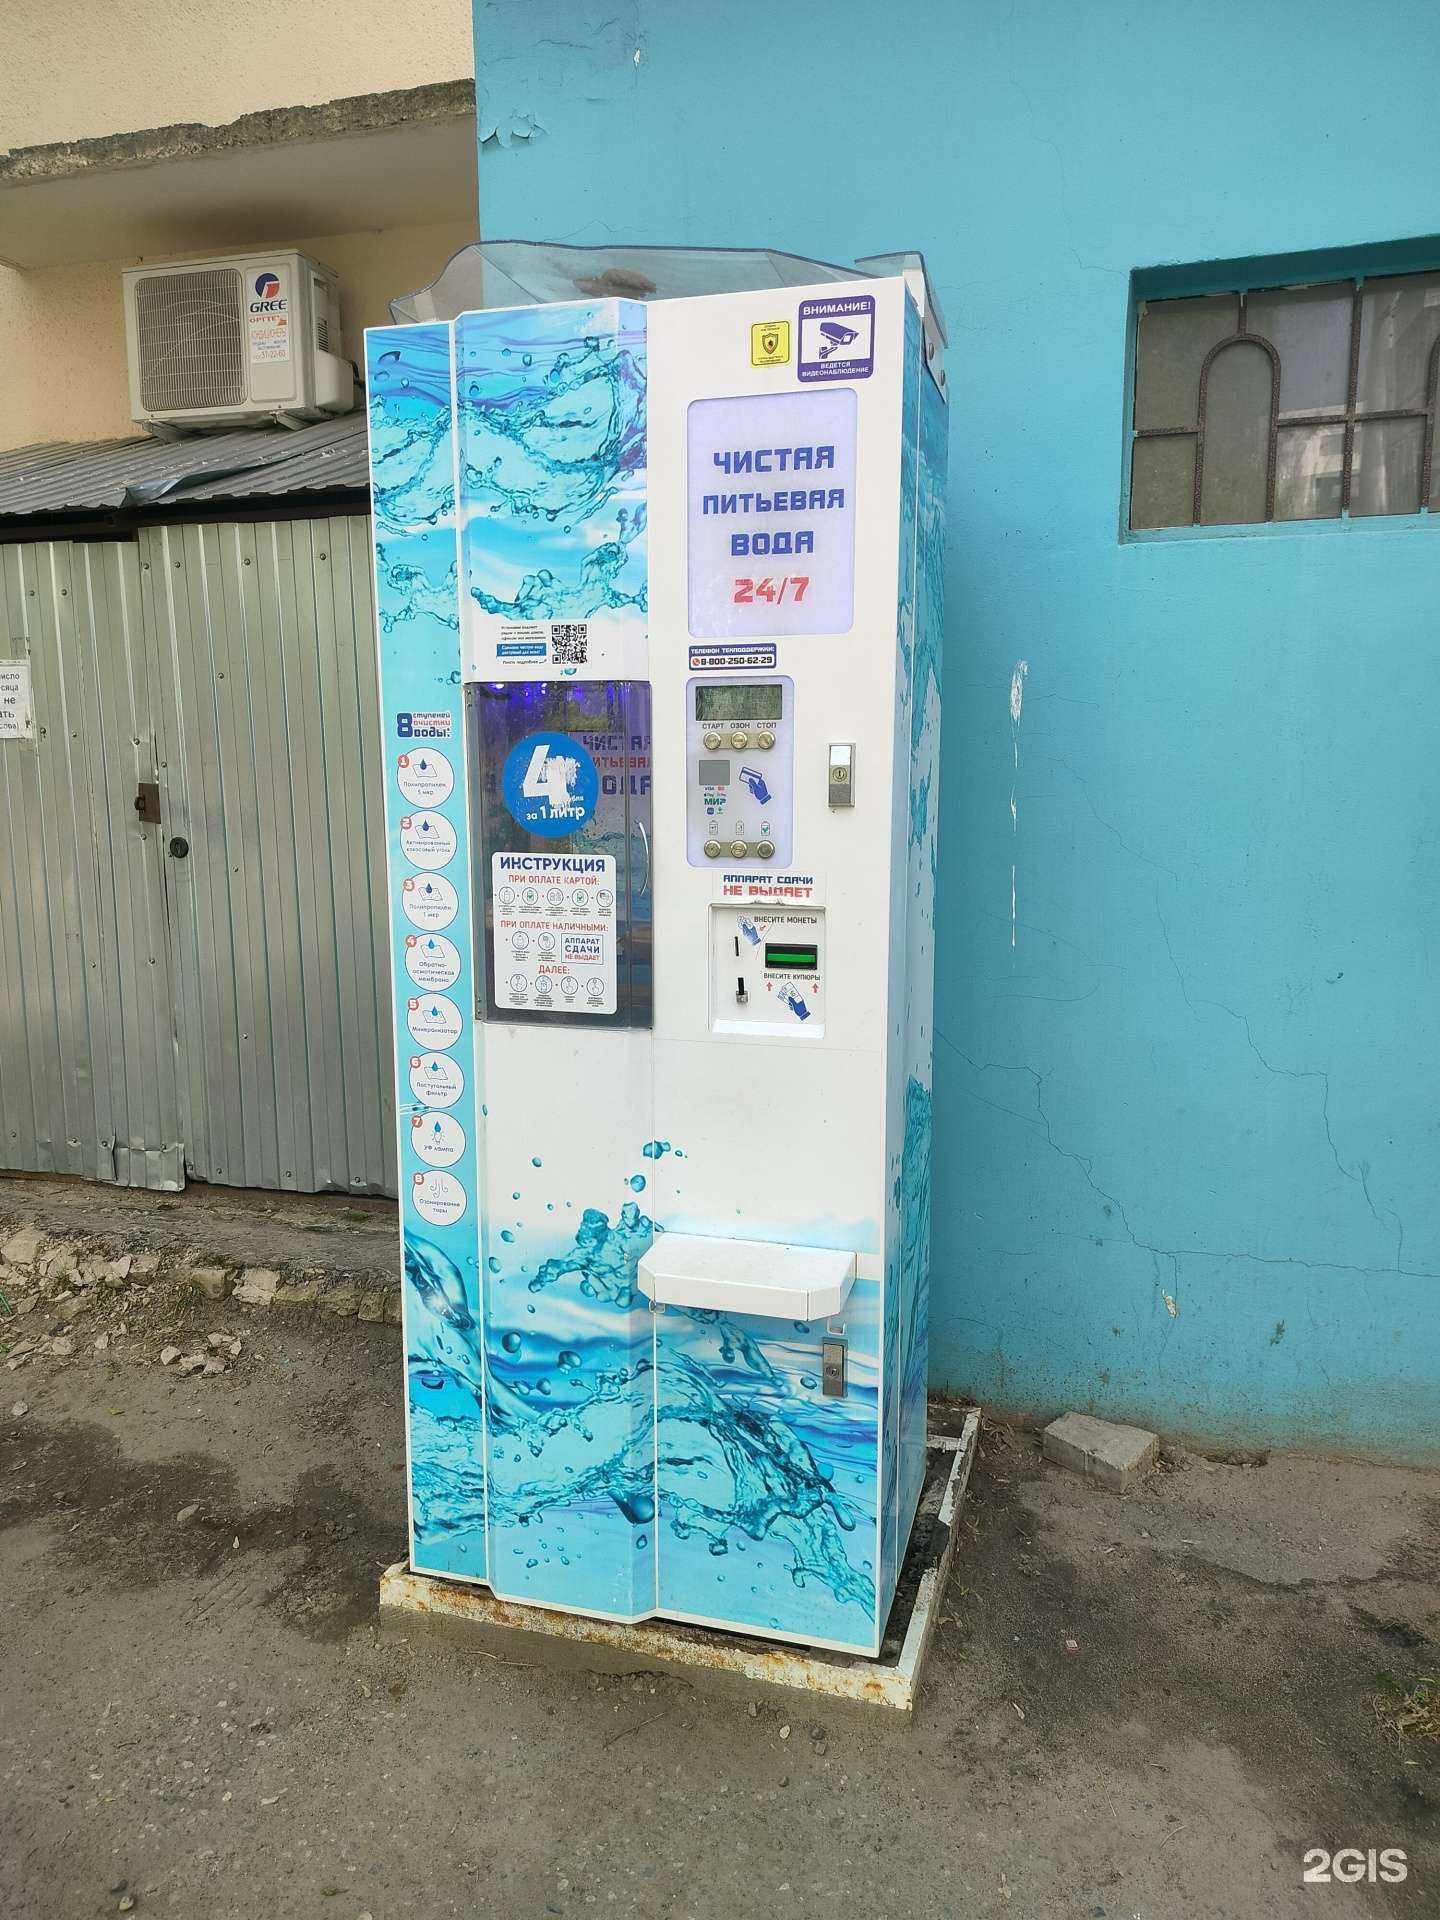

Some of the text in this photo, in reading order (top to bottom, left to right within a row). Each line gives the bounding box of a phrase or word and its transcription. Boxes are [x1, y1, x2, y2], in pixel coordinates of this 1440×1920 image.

[250, 299, 287, 312] GREE
[803, 301, 871, 315] ВНИМАНИЕ!
[820, 361, 851, 369] ВЕДЕТСЯ
[802, 367, 869, 377] ВИДЕОНАБЛЮДЕНИЕ
[713, 446, 834, 474] ЧИСТАЯ
[703, 489, 844, 514] ПИТЬЕВАЯ
[731, 531, 814, 556] ВОДА
[734, 577, 809, 604] 24/7
[397, 713, 413, 738] 8
[702, 721, 777, 730] СТАРТ ОЗОН СТОП
[414, 726, 451, 738] воды:
[540, 806, 547, 819] 1
[549, 807, 585, 820] литр
[501, 857, 605, 873] ИНСТРУКЦИЯ
[508, 874, 600, 886] ПРИ ОПЛАТЕ КАРТОЙ:
[723, 875, 813, 885] АППАРАТ СДАЧИ
[723, 885, 813, 898] НЕ ВЫДАЕТ
[501, 920, 609, 932] ПРИ ОПЛАТЕ НАЛИЧНЫМИ:
[786, 916, 817, 924] МОНЕТЫ
[565, 937, 600, 945] АППАРАТ
[565, 945, 600, 953] СДАЧИ
[538, 965, 570, 975] ДАЛЕЕ:
